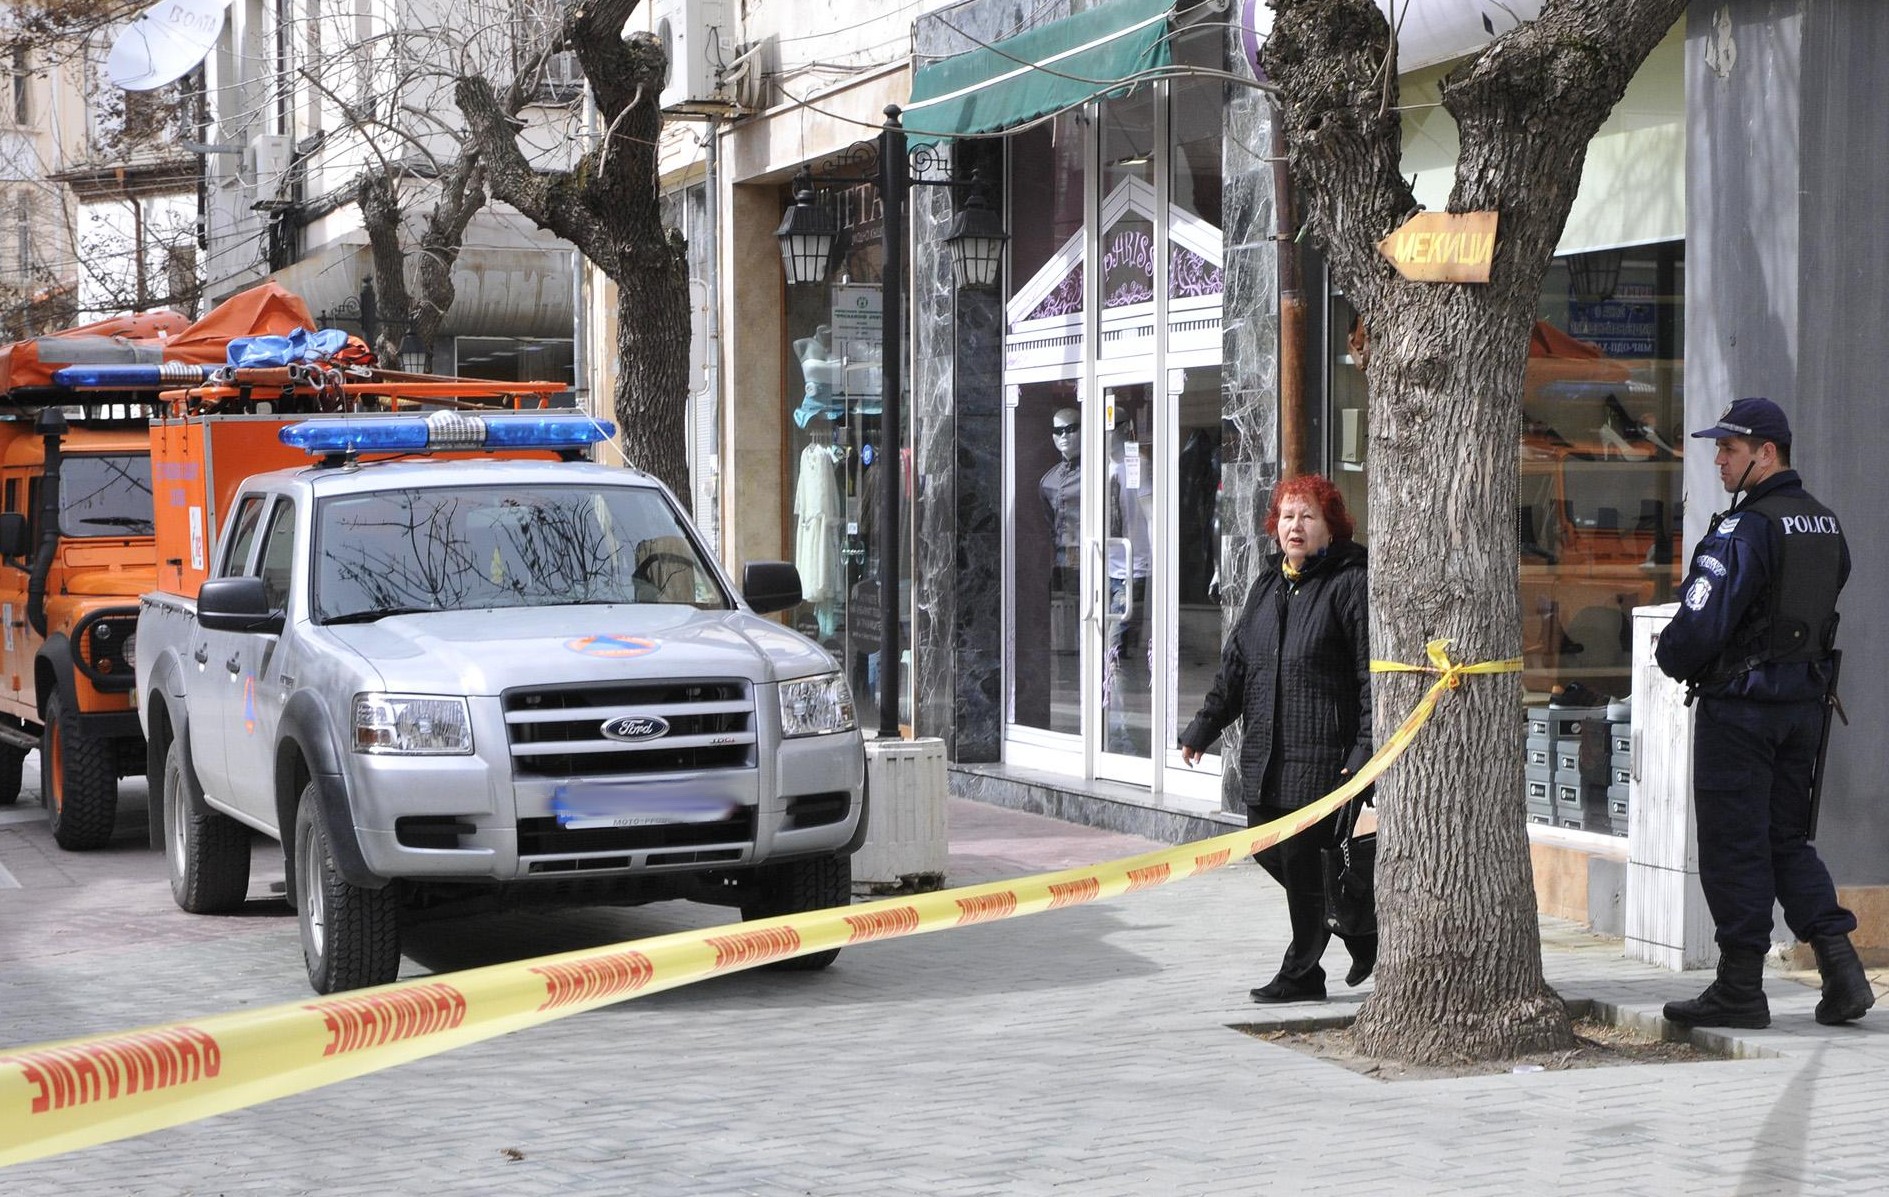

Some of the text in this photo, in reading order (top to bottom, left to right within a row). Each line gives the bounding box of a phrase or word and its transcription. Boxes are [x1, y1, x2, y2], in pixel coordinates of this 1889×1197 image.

[1394, 232, 1494, 266] МЕКИЦИ
[1781, 515, 1839, 535] POLICE
[618, 719, 654, 736] Ford
